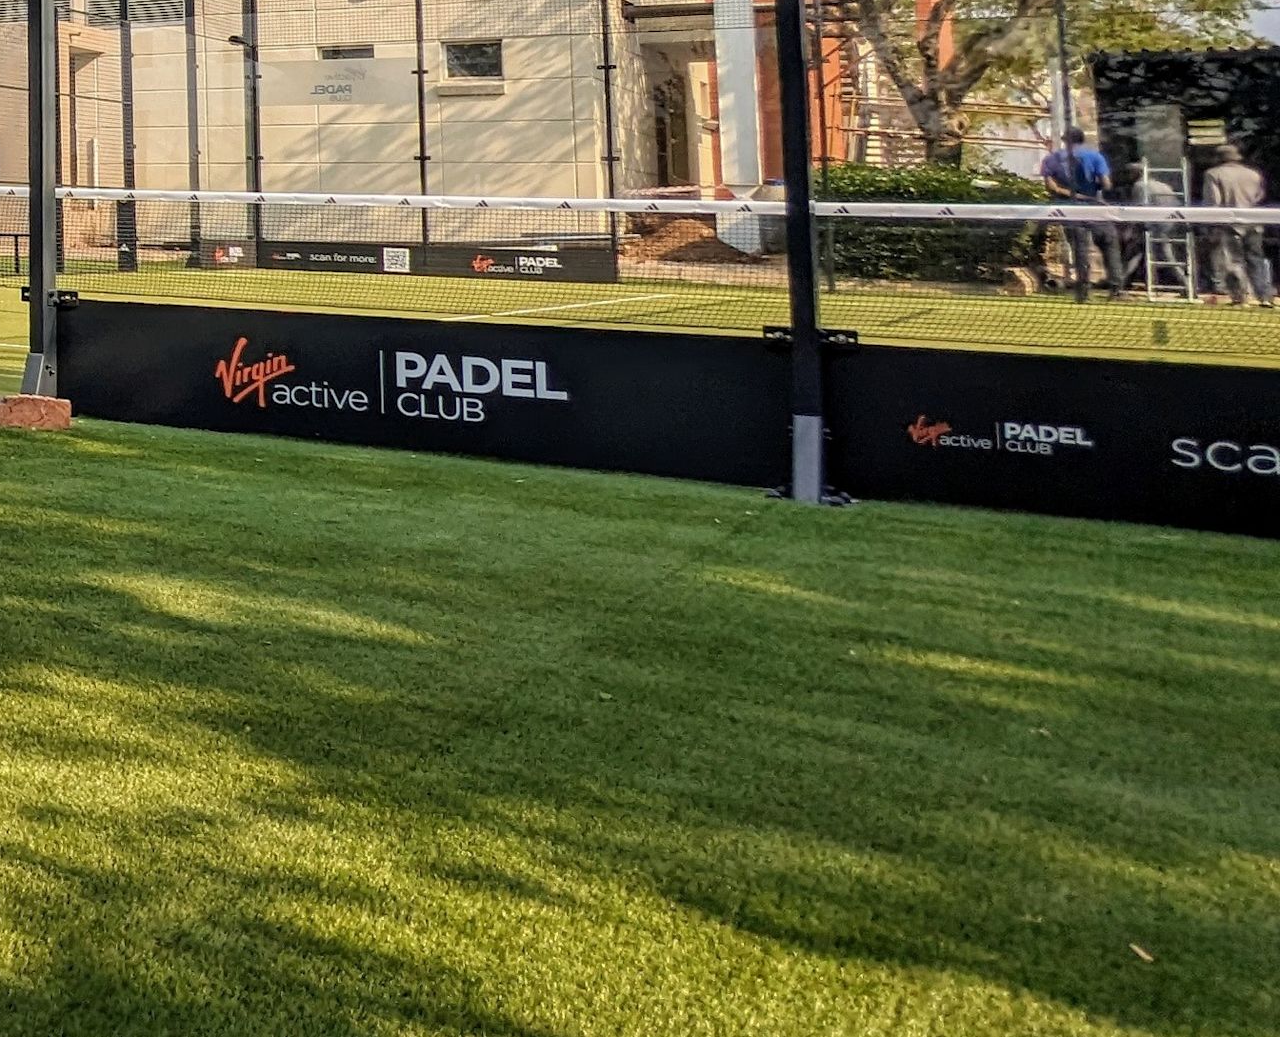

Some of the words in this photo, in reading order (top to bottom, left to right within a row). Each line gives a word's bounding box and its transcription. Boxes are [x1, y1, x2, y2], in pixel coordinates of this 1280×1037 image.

[310, 254, 332, 262] scan
[333, 253, 347, 262] for
[519, 257, 562, 268] PADEL
[214, 337, 295, 407] Virgin
[272, 381, 369, 412] active
[395, 351, 568, 401] PADEL
[397, 393, 486, 422] CLUB
[939, 434, 991, 450] active
[1004, 422, 1094, 447] PADEL
[1005, 439, 1054, 455] CLUB
